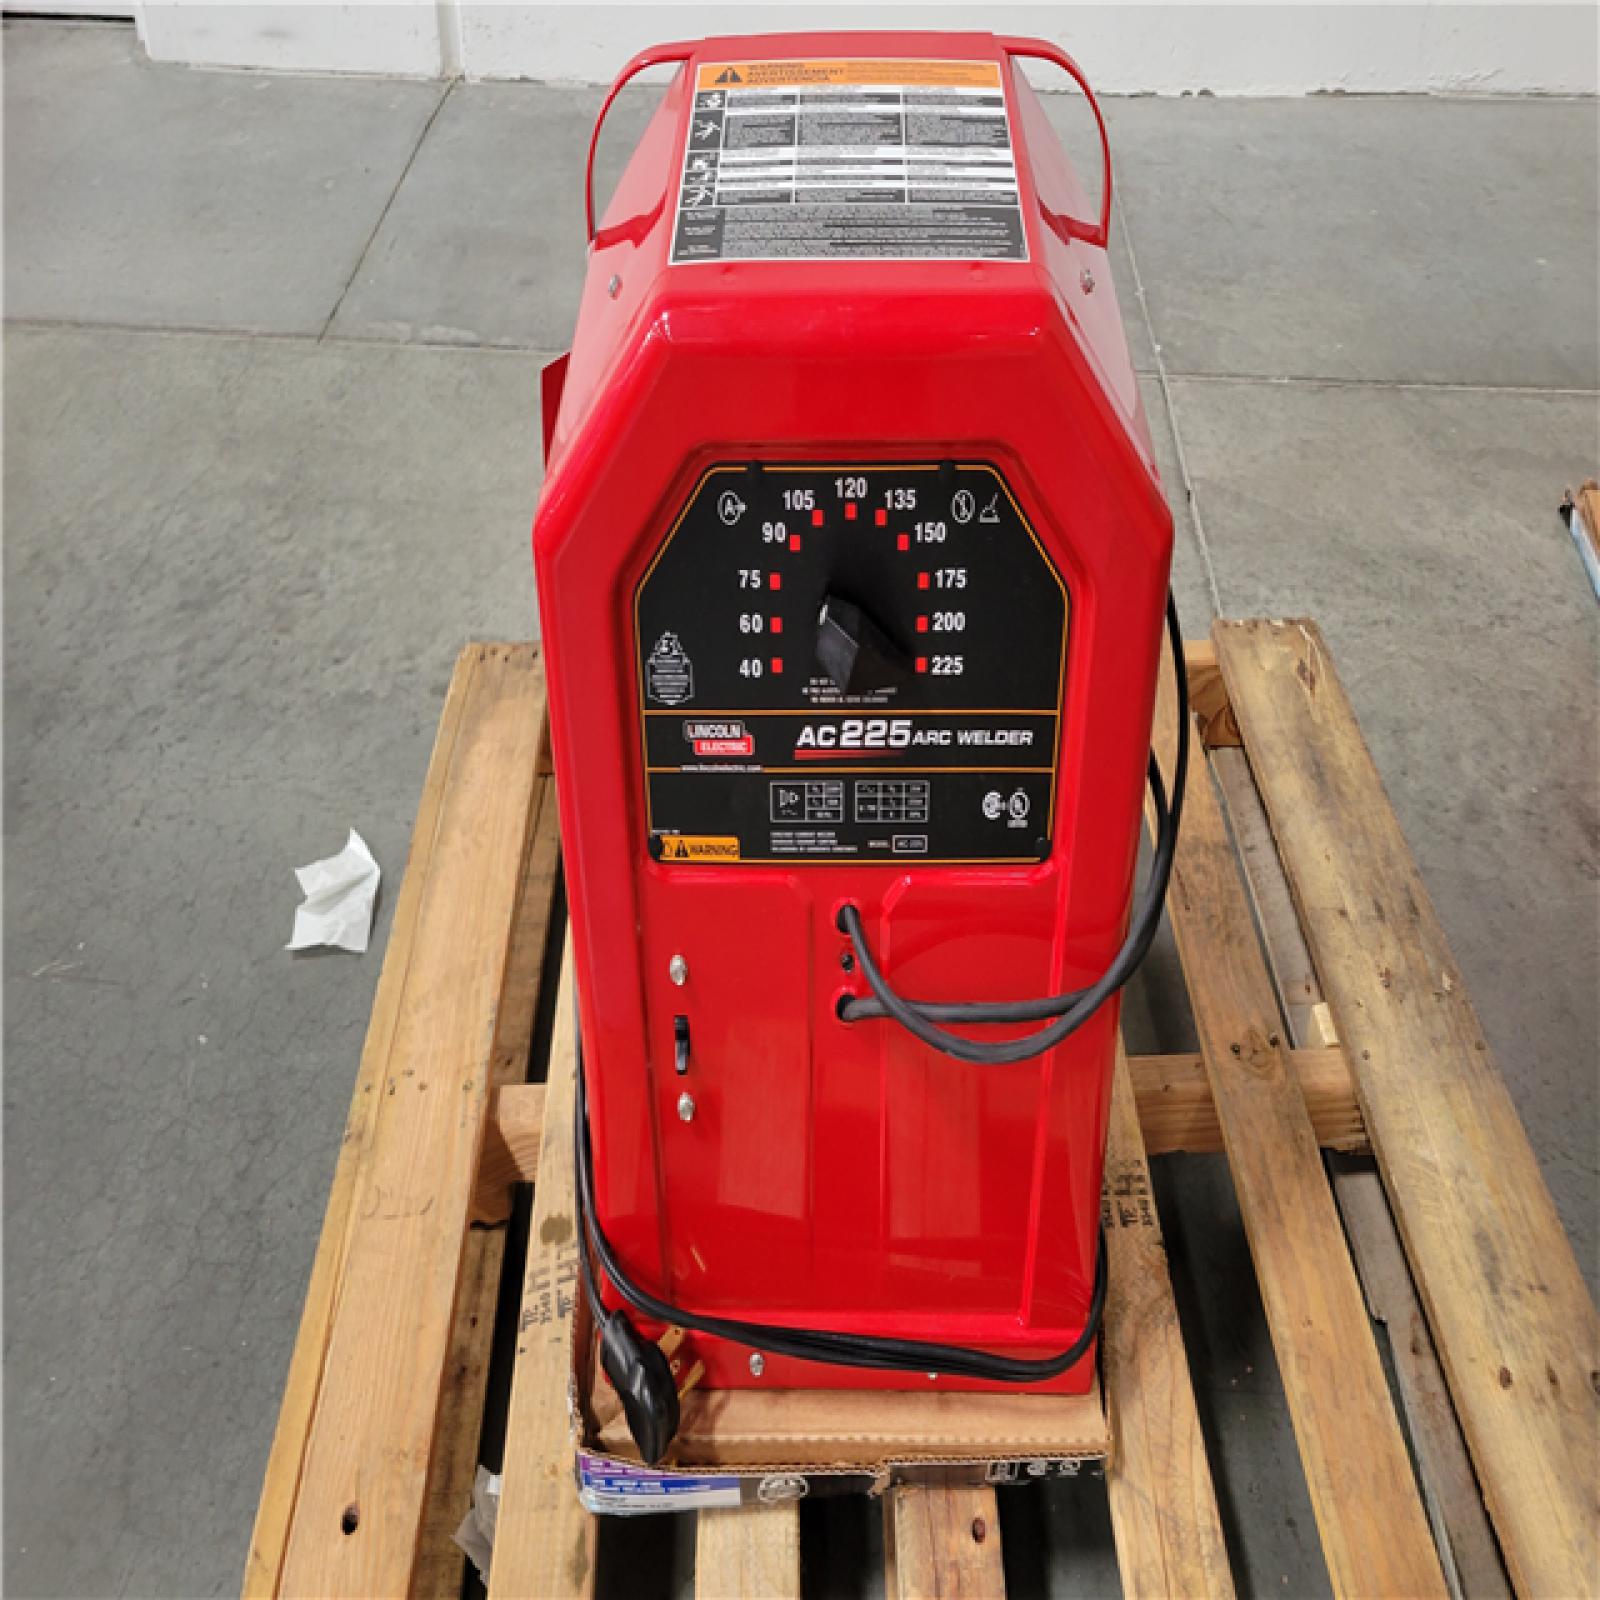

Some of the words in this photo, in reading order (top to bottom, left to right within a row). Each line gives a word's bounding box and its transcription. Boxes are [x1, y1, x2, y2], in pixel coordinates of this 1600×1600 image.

[834, 477, 868, 499] 120
[782, 489, 816, 511] 105
[884, 489, 917, 511] 135
[761, 521, 786, 544] 90
[914, 521, 947, 543] 150
[739, 569, 763, 590] 75
[934, 569, 967, 590] 175
[739, 613, 764, 634] 60
[932, 611, 966, 632] 200
[739, 657, 763, 678] 40
[931, 655, 964, 676] 225
[687, 724, 741, 739] LINCOLN
[912, 730, 953, 746] ARC
[956, 730, 1034, 746] WELDER
[700, 741, 748, 751] ELECTRIC
[688, 844, 739, 855] WARNING
